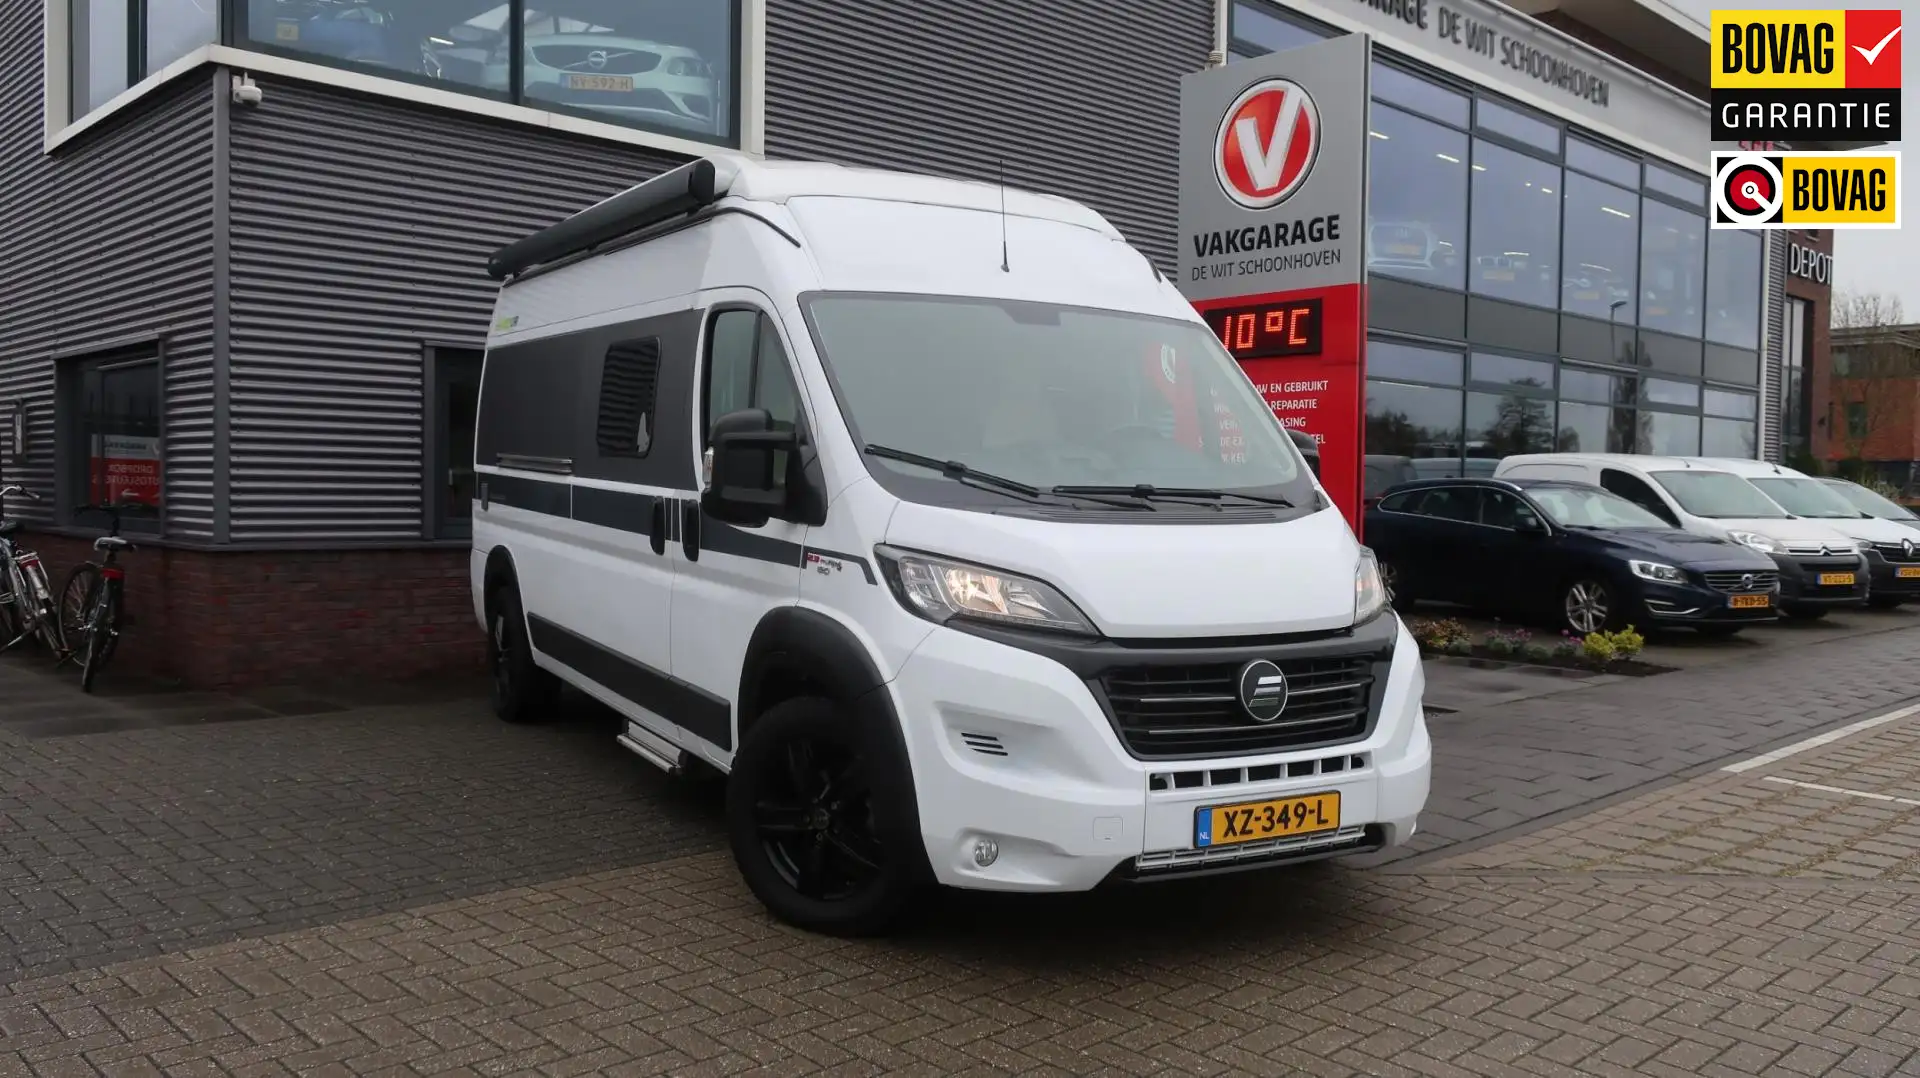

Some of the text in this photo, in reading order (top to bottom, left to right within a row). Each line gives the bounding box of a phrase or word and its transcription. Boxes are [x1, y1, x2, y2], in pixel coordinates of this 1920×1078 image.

[1438, 7, 1461, 45] DE
[1465, 19, 1498, 60] WIT
[1500, 36, 1610, 107] SCHOONHOVEN
[1193, 214, 1341, 258] VAKGARAGE
[1191, 249, 1341, 282] DE WIT SCHOONHOVEN
[1790, 242, 1834, 285] DEPOT
[1270, 383, 1282, 393] EN
[1284, 380, 1329, 393] GEBRUIKT
[1270, 398, 1318, 410] REPARATIE
[1199, 799, 1329, 840] NL XZ-349-L
